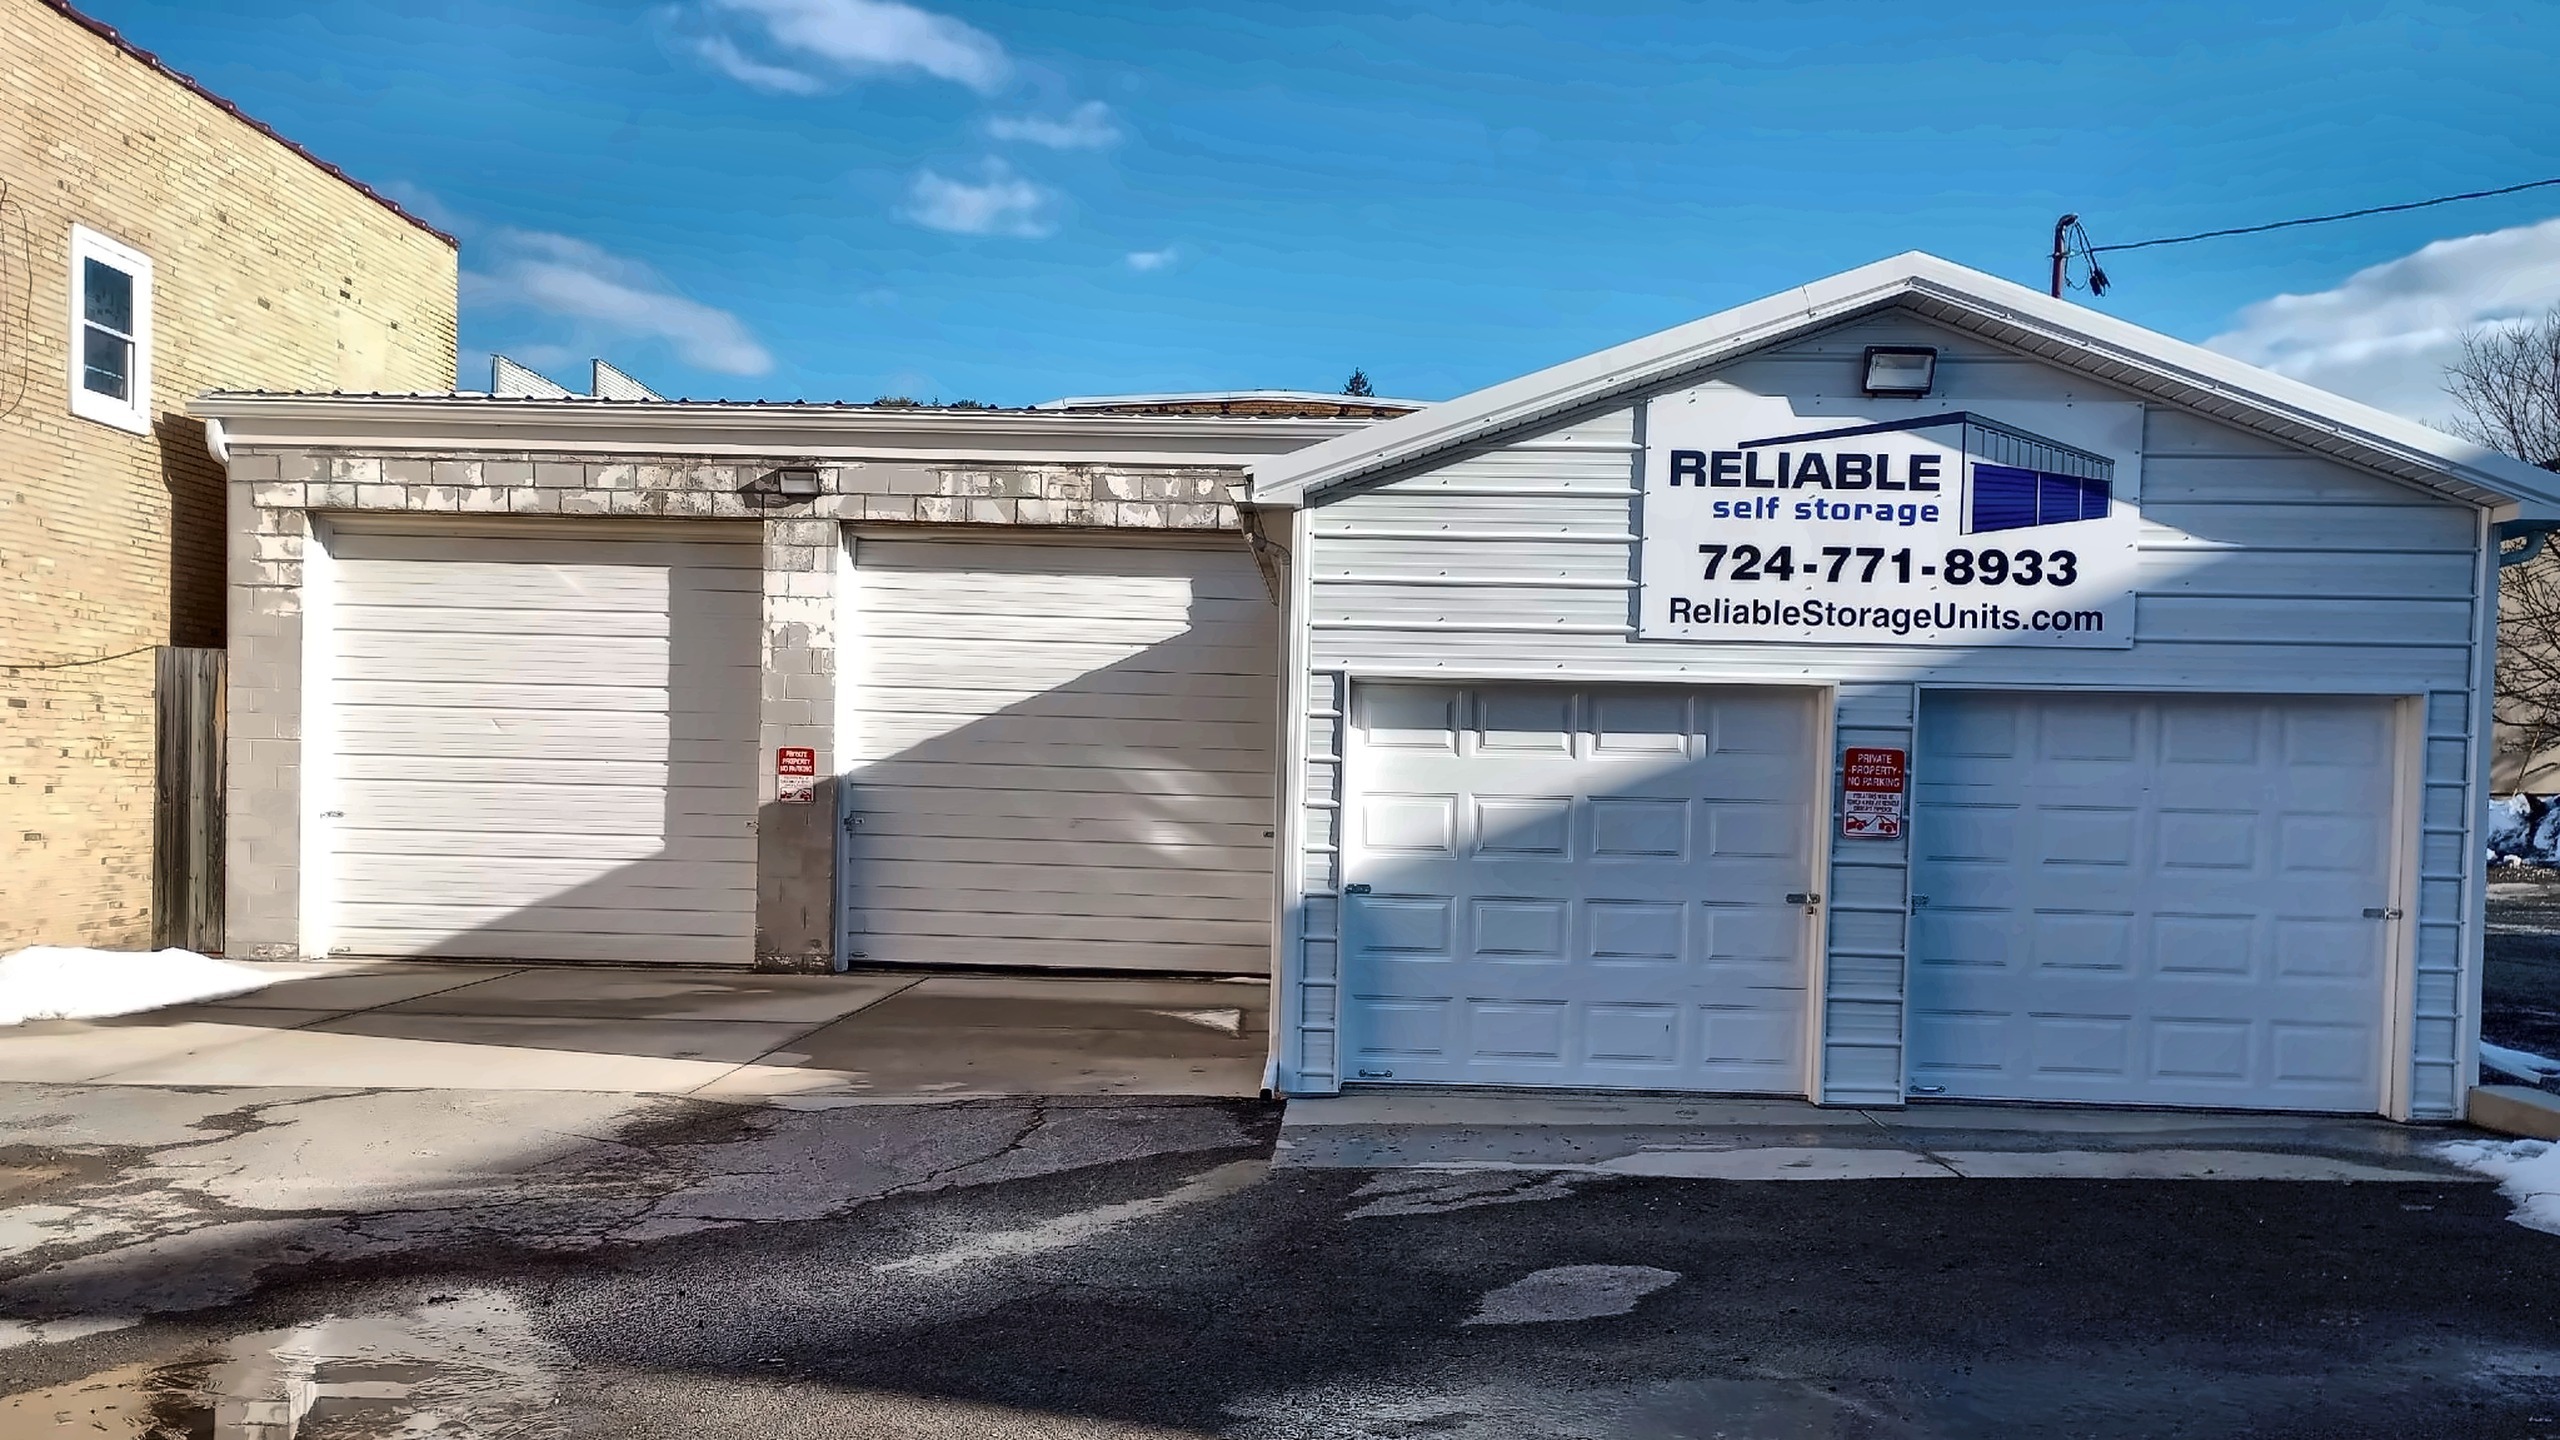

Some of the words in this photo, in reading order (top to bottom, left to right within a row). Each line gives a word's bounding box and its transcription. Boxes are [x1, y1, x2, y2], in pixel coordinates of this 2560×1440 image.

[1670, 449, 1942, 492] RELIABLE
[1713, 496, 1780, 520] self
[1795, 498, 1939, 527] storage
[1698, 544, 2078, 587] 724-771-8933
[1669, 597, 2104, 636] ReliableStorageUnits.com
[1851, 765, 1897, 775] PROPERTY
[1857, 754, 1892, 763] PRIVATE
[1847, 776, 1860, 786] NO
[1862, 777, 1900, 787] PARKING
